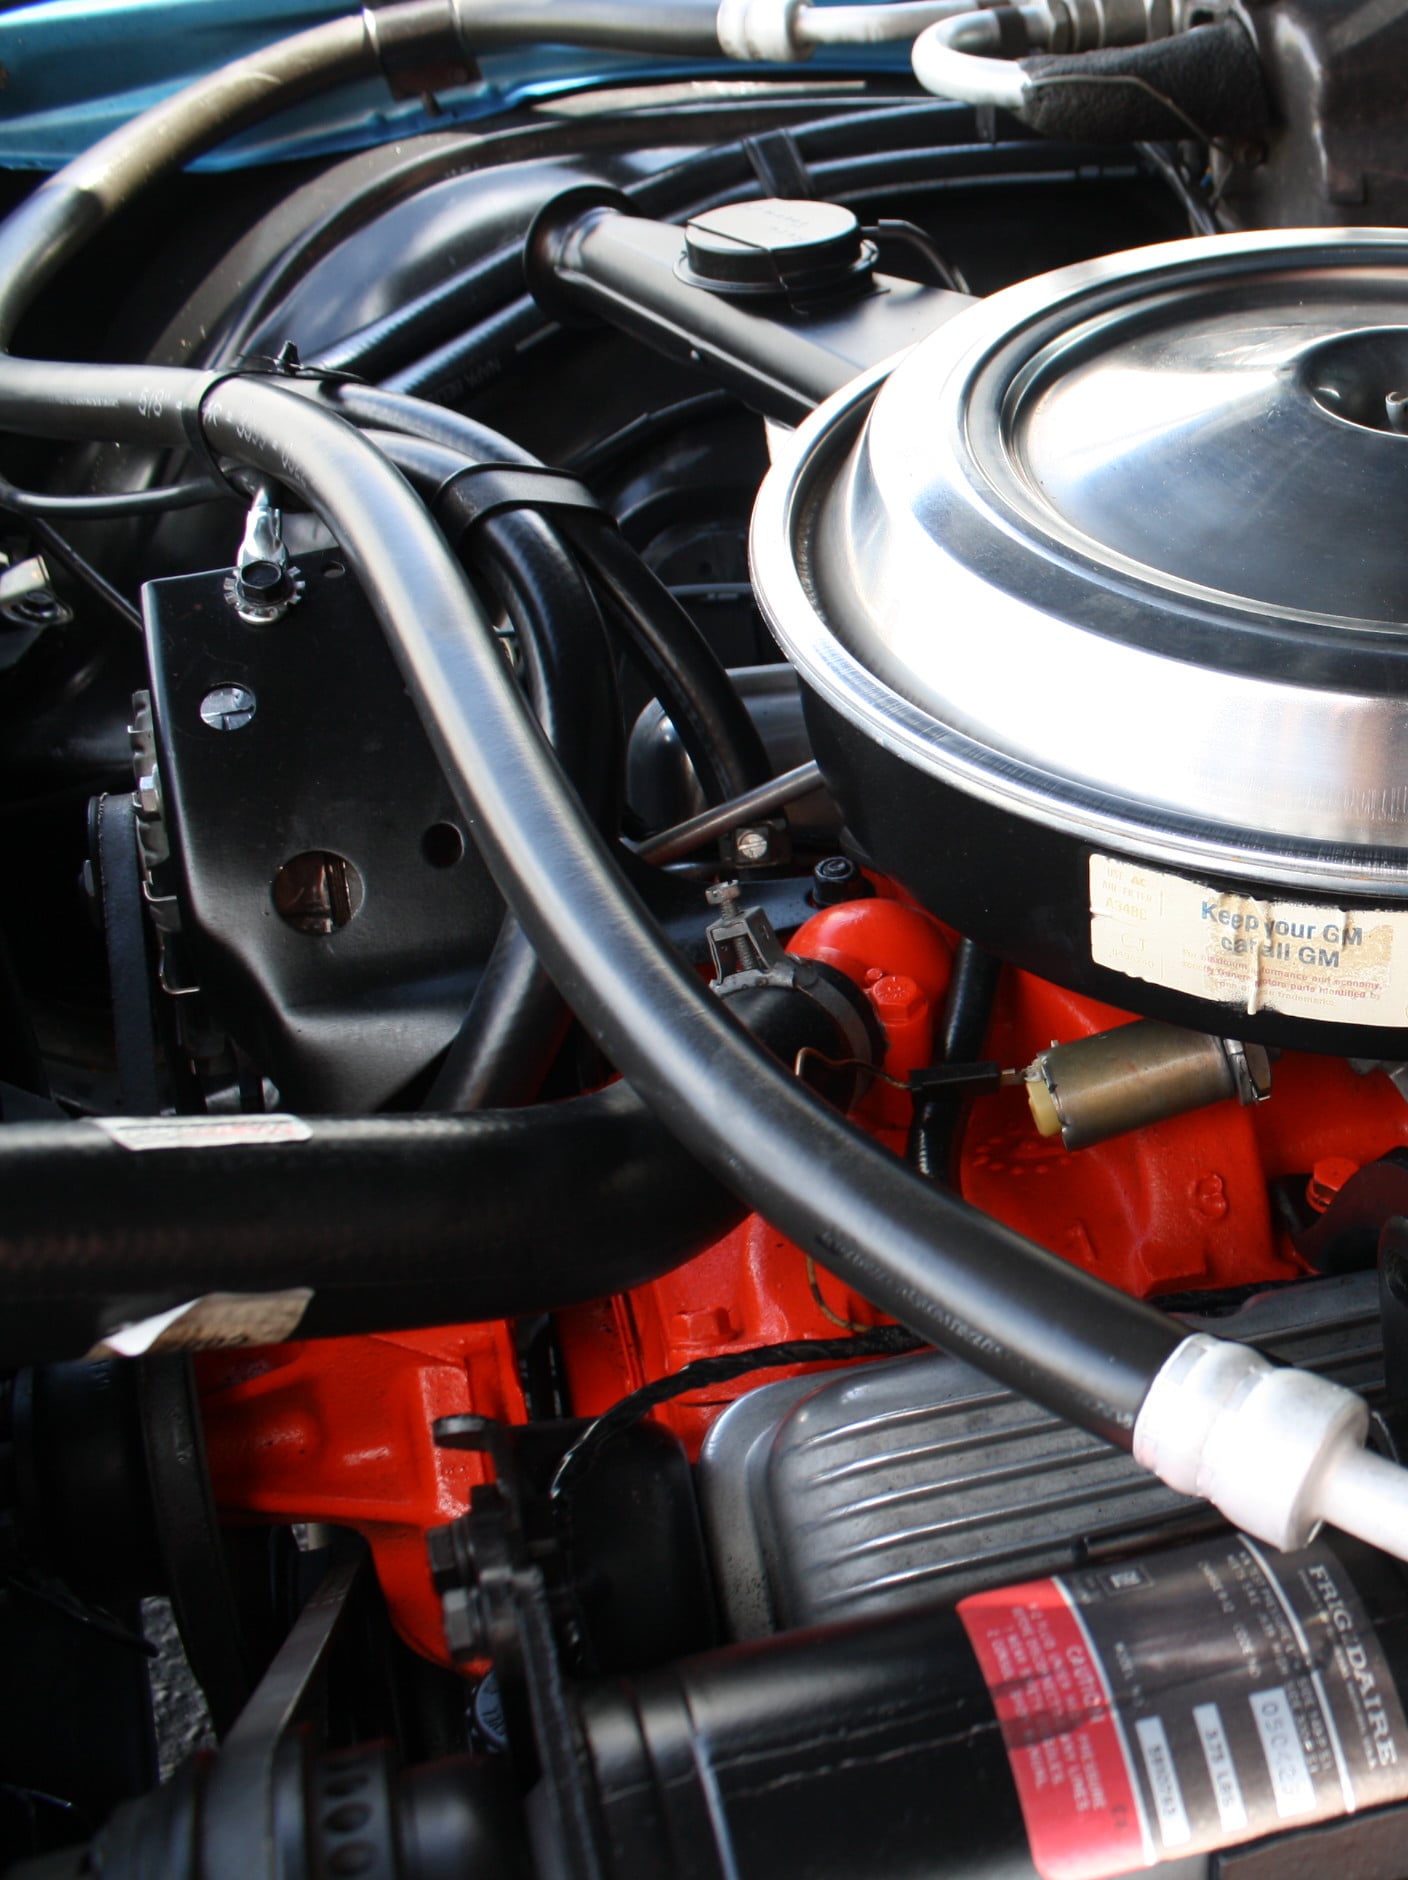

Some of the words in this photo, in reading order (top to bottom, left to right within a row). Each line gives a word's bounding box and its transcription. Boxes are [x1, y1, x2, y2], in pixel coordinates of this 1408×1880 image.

[1201, 900, 1259, 933] Keep
[1264, 918, 1316, 941] your
[1322, 923, 1363, 948] GM
[1261, 937, 1291, 961] all
[1297, 945, 1340, 969] GM
[1064, 1642, 1107, 1726] CAUTION
